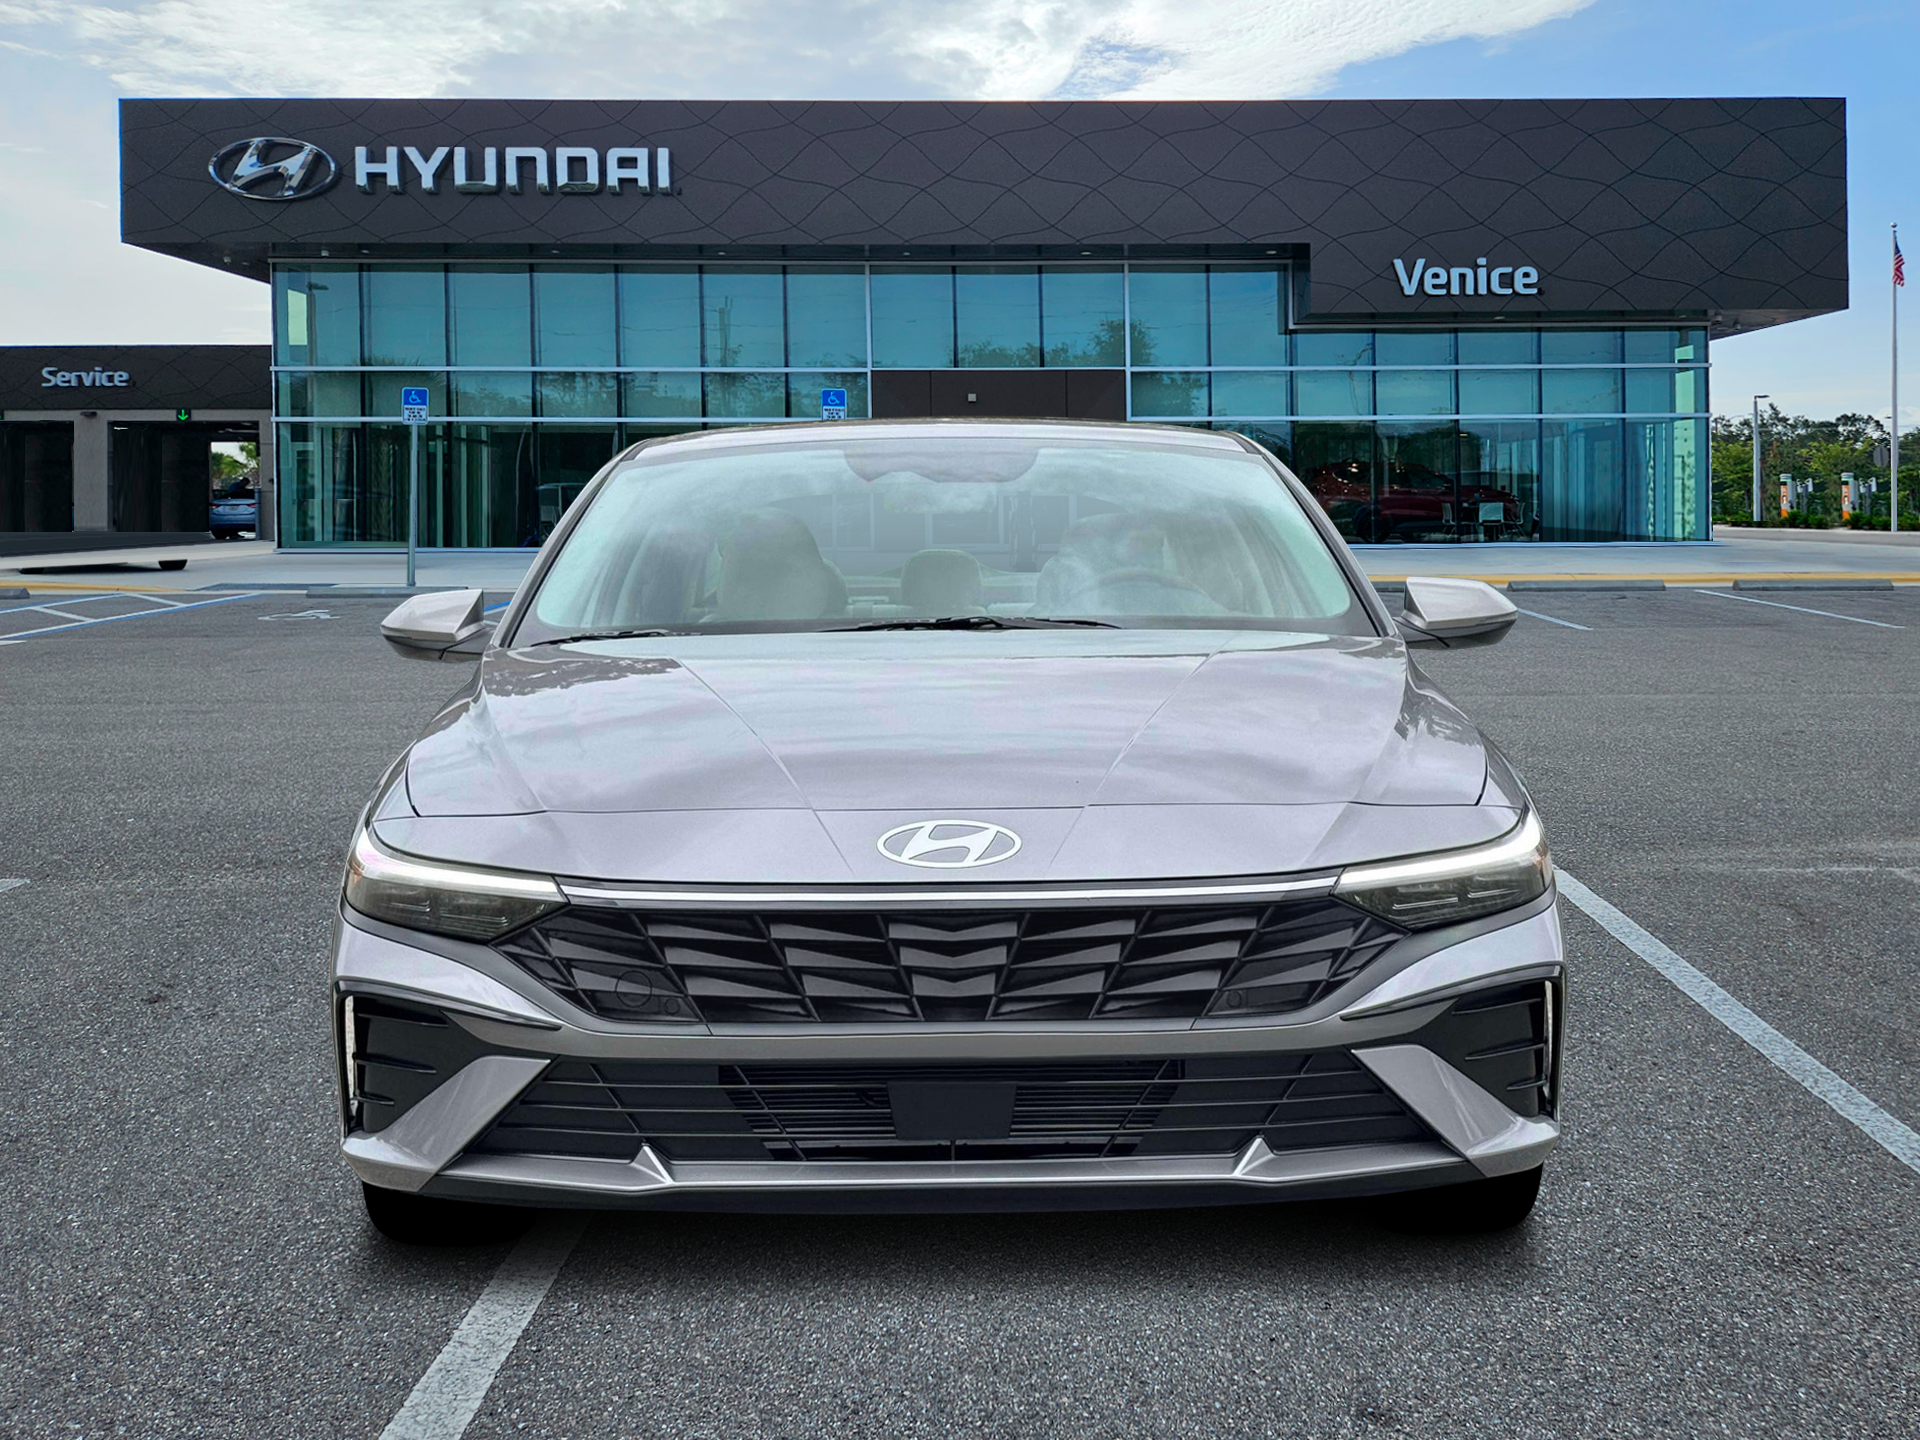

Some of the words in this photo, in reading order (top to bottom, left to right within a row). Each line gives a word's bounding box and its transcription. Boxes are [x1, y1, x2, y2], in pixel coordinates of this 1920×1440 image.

[354, 146, 671, 194] HYUNDAI
[1393, 257, 1539, 296] Venice
[41, 366, 130, 387] Service
